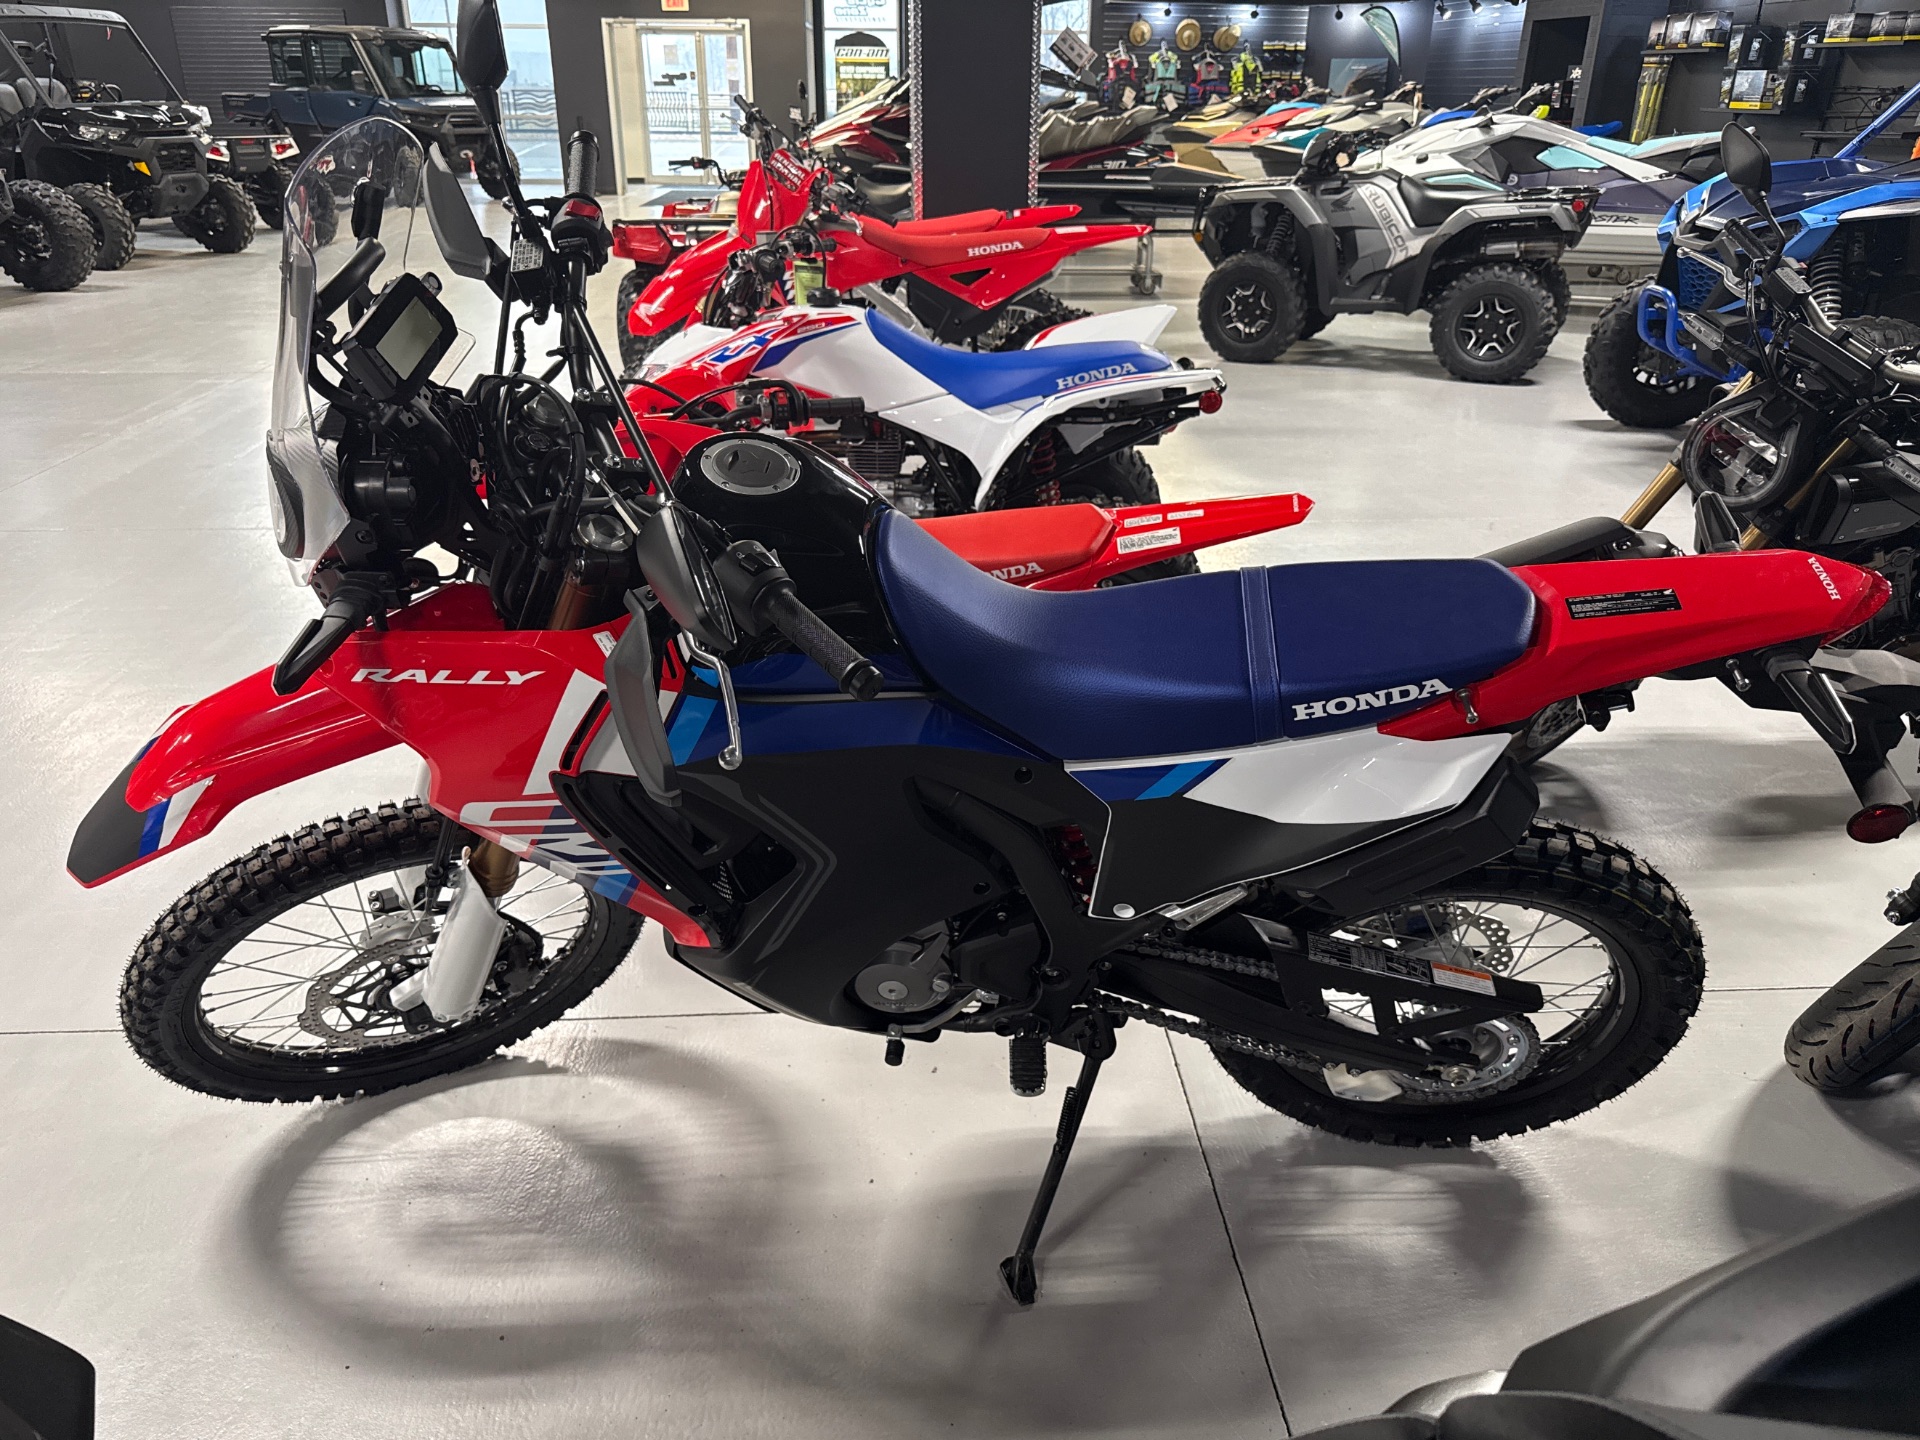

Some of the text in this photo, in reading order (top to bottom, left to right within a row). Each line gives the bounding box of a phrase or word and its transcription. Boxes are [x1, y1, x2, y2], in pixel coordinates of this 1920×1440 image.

[1364, 186, 1410, 258] RUBICON
[967, 241, 1024, 257] HONDA
[1056, 363, 1139, 390] HONDA
[1807, 556, 1842, 601] HONDA
[350, 668, 547, 686] RALLY
[1292, 677, 1454, 721] HONDA
